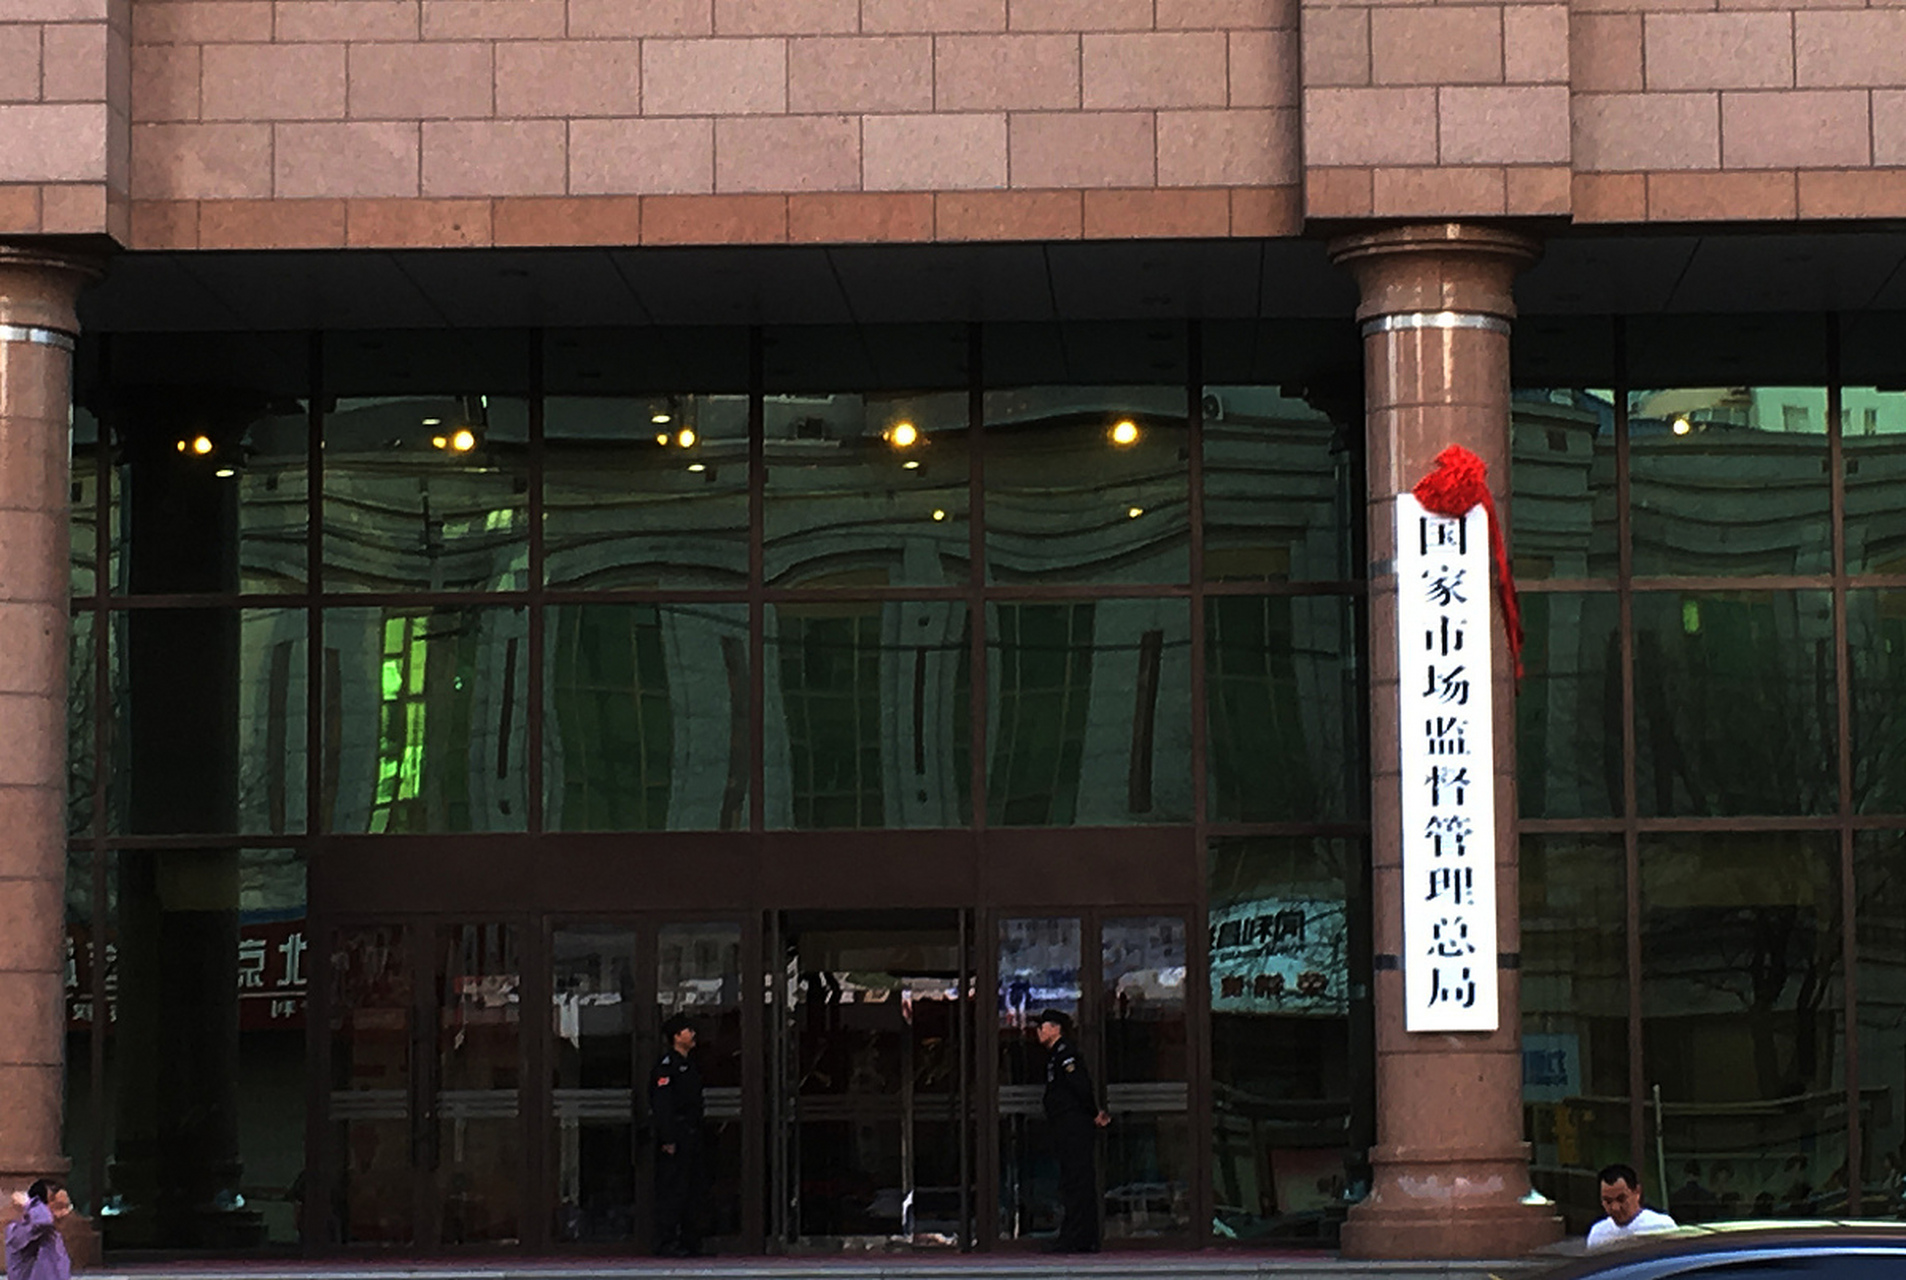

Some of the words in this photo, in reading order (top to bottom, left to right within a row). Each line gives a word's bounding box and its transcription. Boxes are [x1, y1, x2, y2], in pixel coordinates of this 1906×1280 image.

[1419, 516, 1475, 1008] 国家市场监督管理总局
